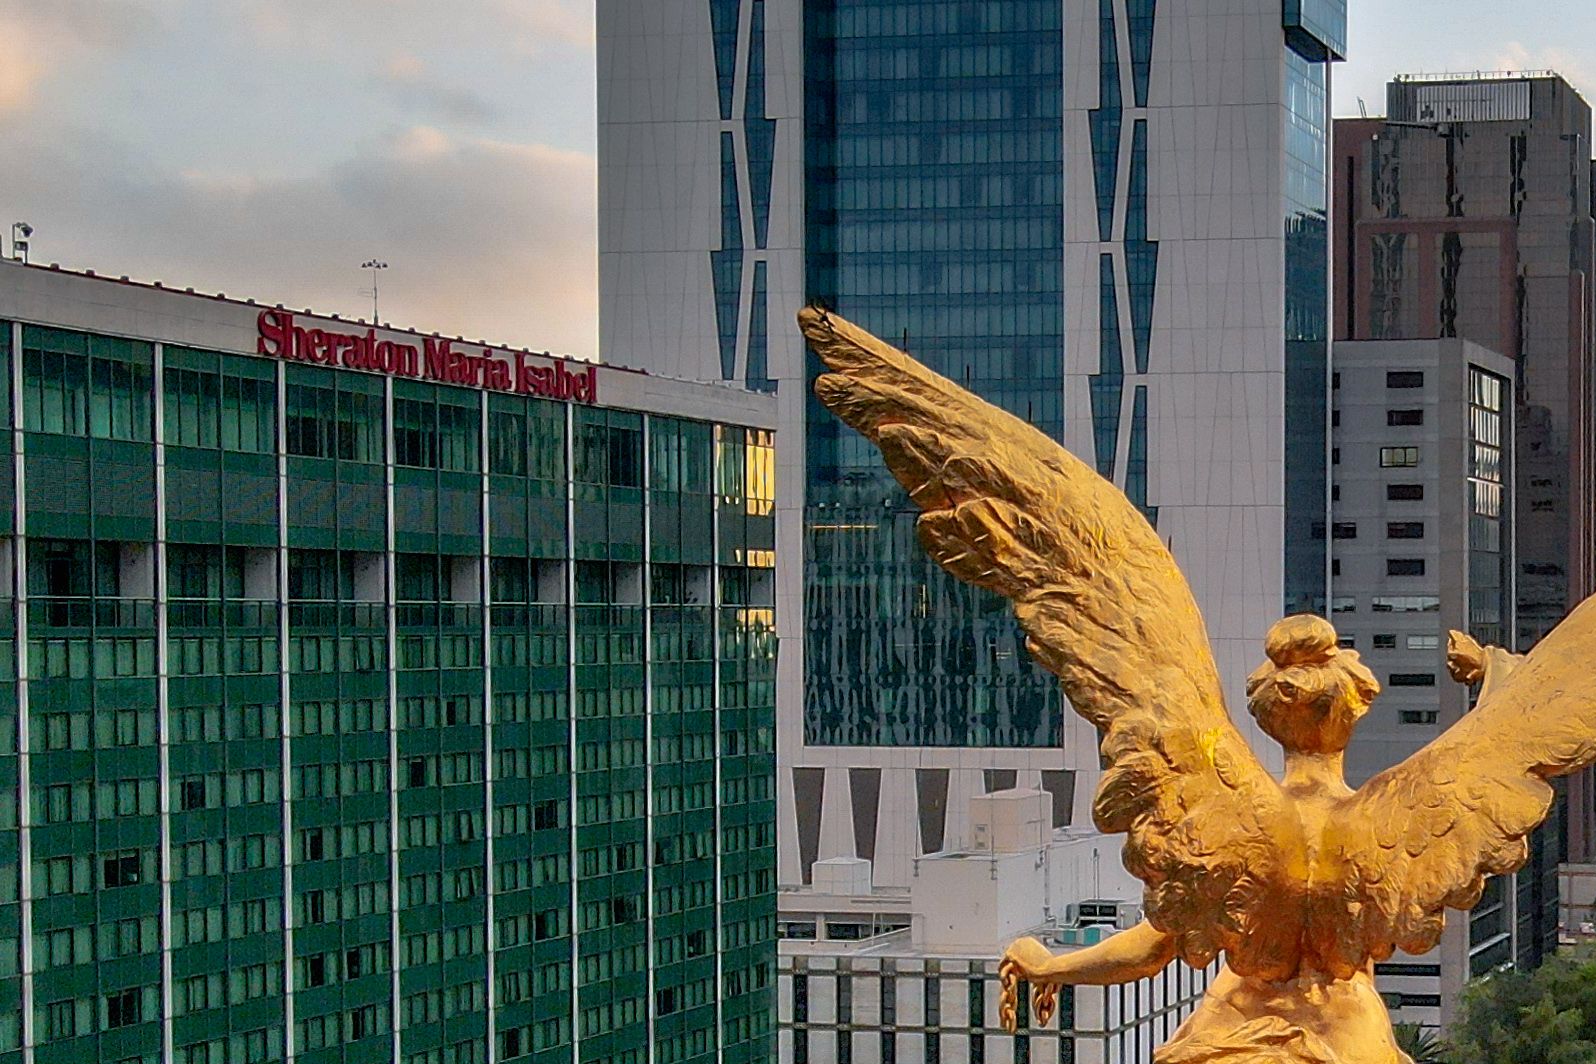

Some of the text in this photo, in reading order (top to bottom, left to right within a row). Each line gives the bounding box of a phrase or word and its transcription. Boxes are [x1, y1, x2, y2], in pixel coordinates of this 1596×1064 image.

[257, 309, 597, 403] Sheraton Maria Isabel
